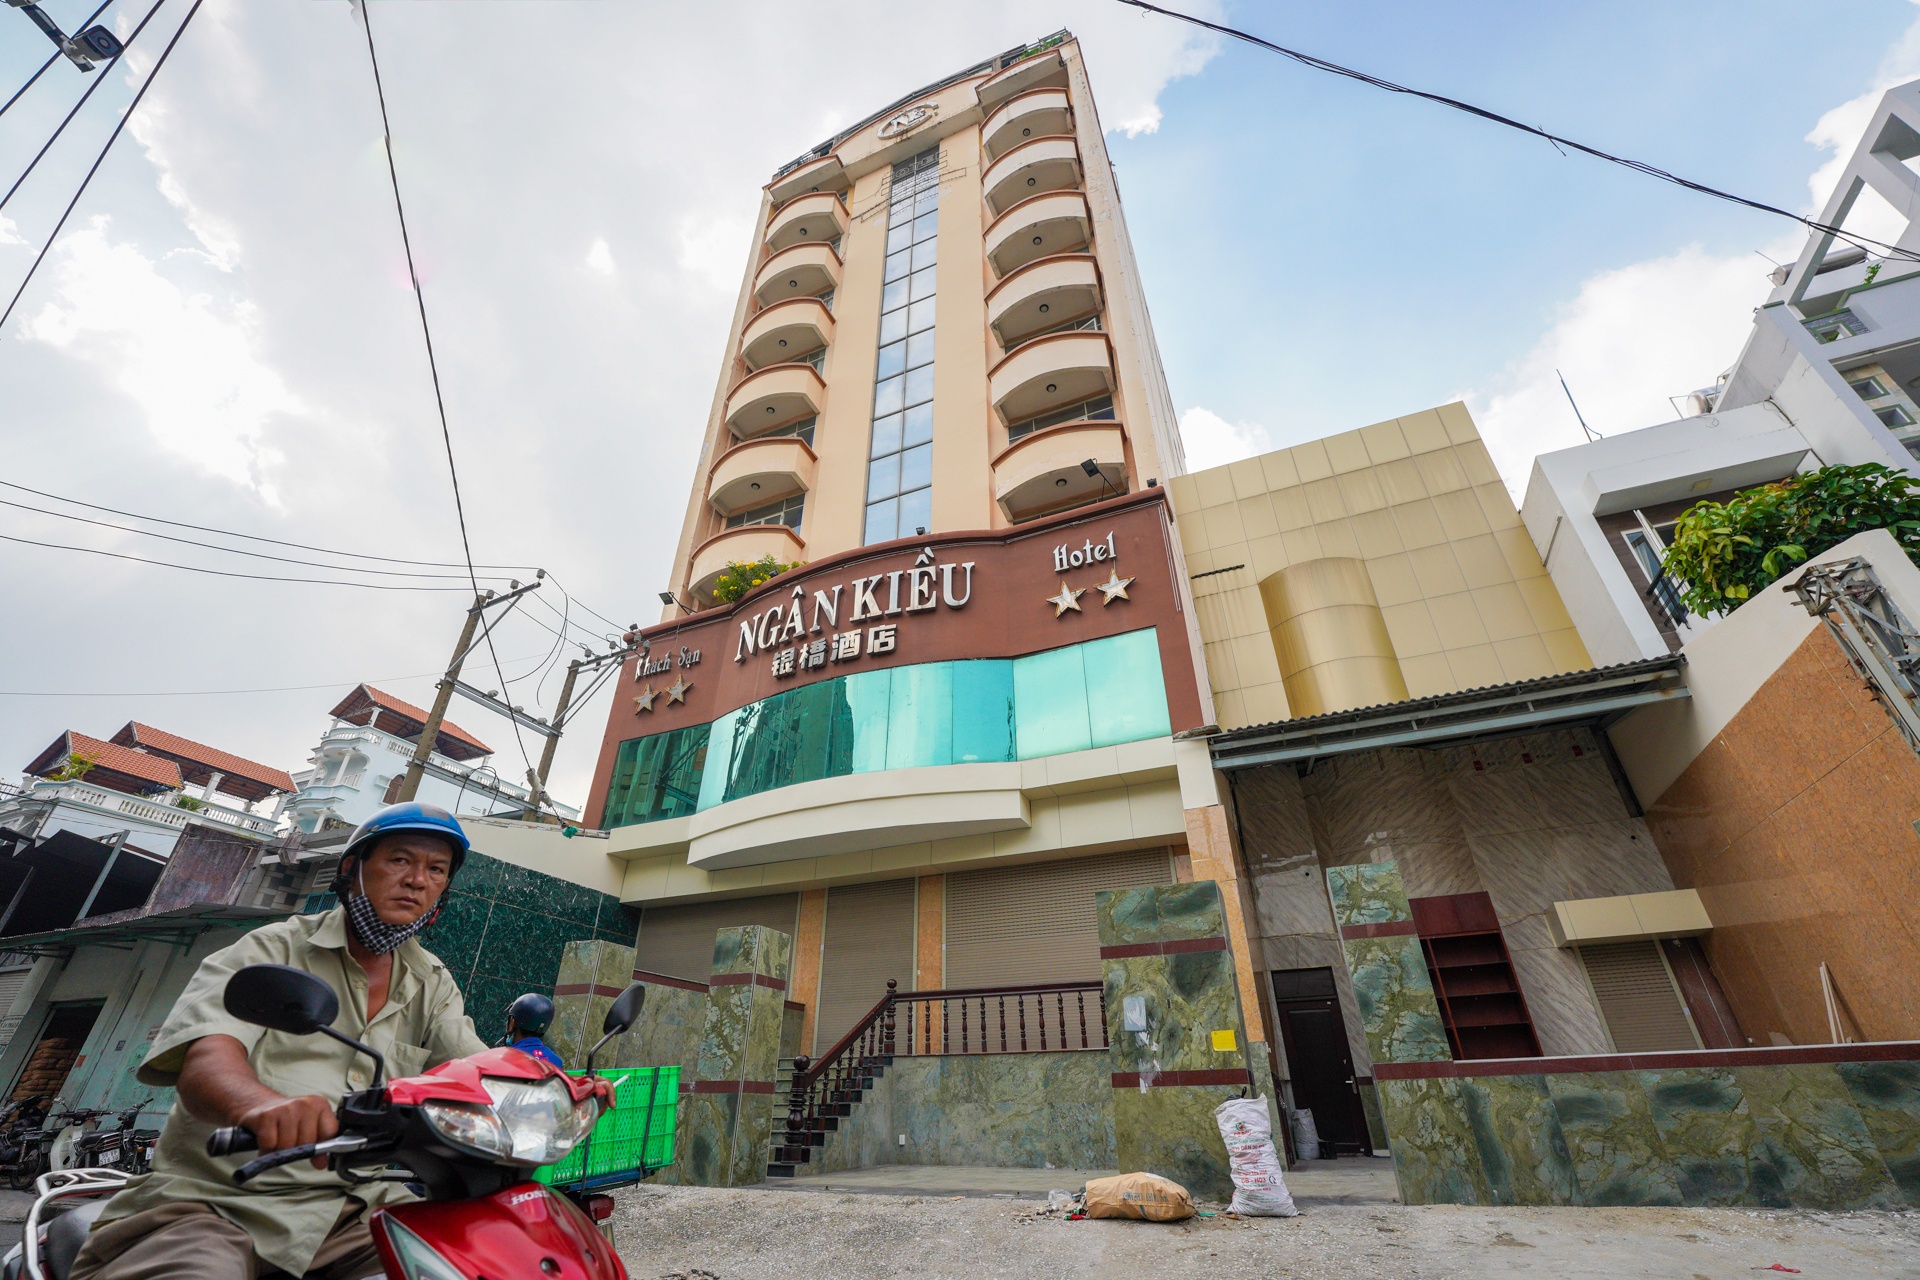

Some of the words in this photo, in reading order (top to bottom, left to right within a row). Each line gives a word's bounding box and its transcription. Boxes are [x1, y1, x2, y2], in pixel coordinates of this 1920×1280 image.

[1053, 530, 1117, 572] Hotel
[734, 585, 844, 664] NGÂN
[849, 547, 976, 623] KIỀU
[677, 645, 700, 669] Sạn
